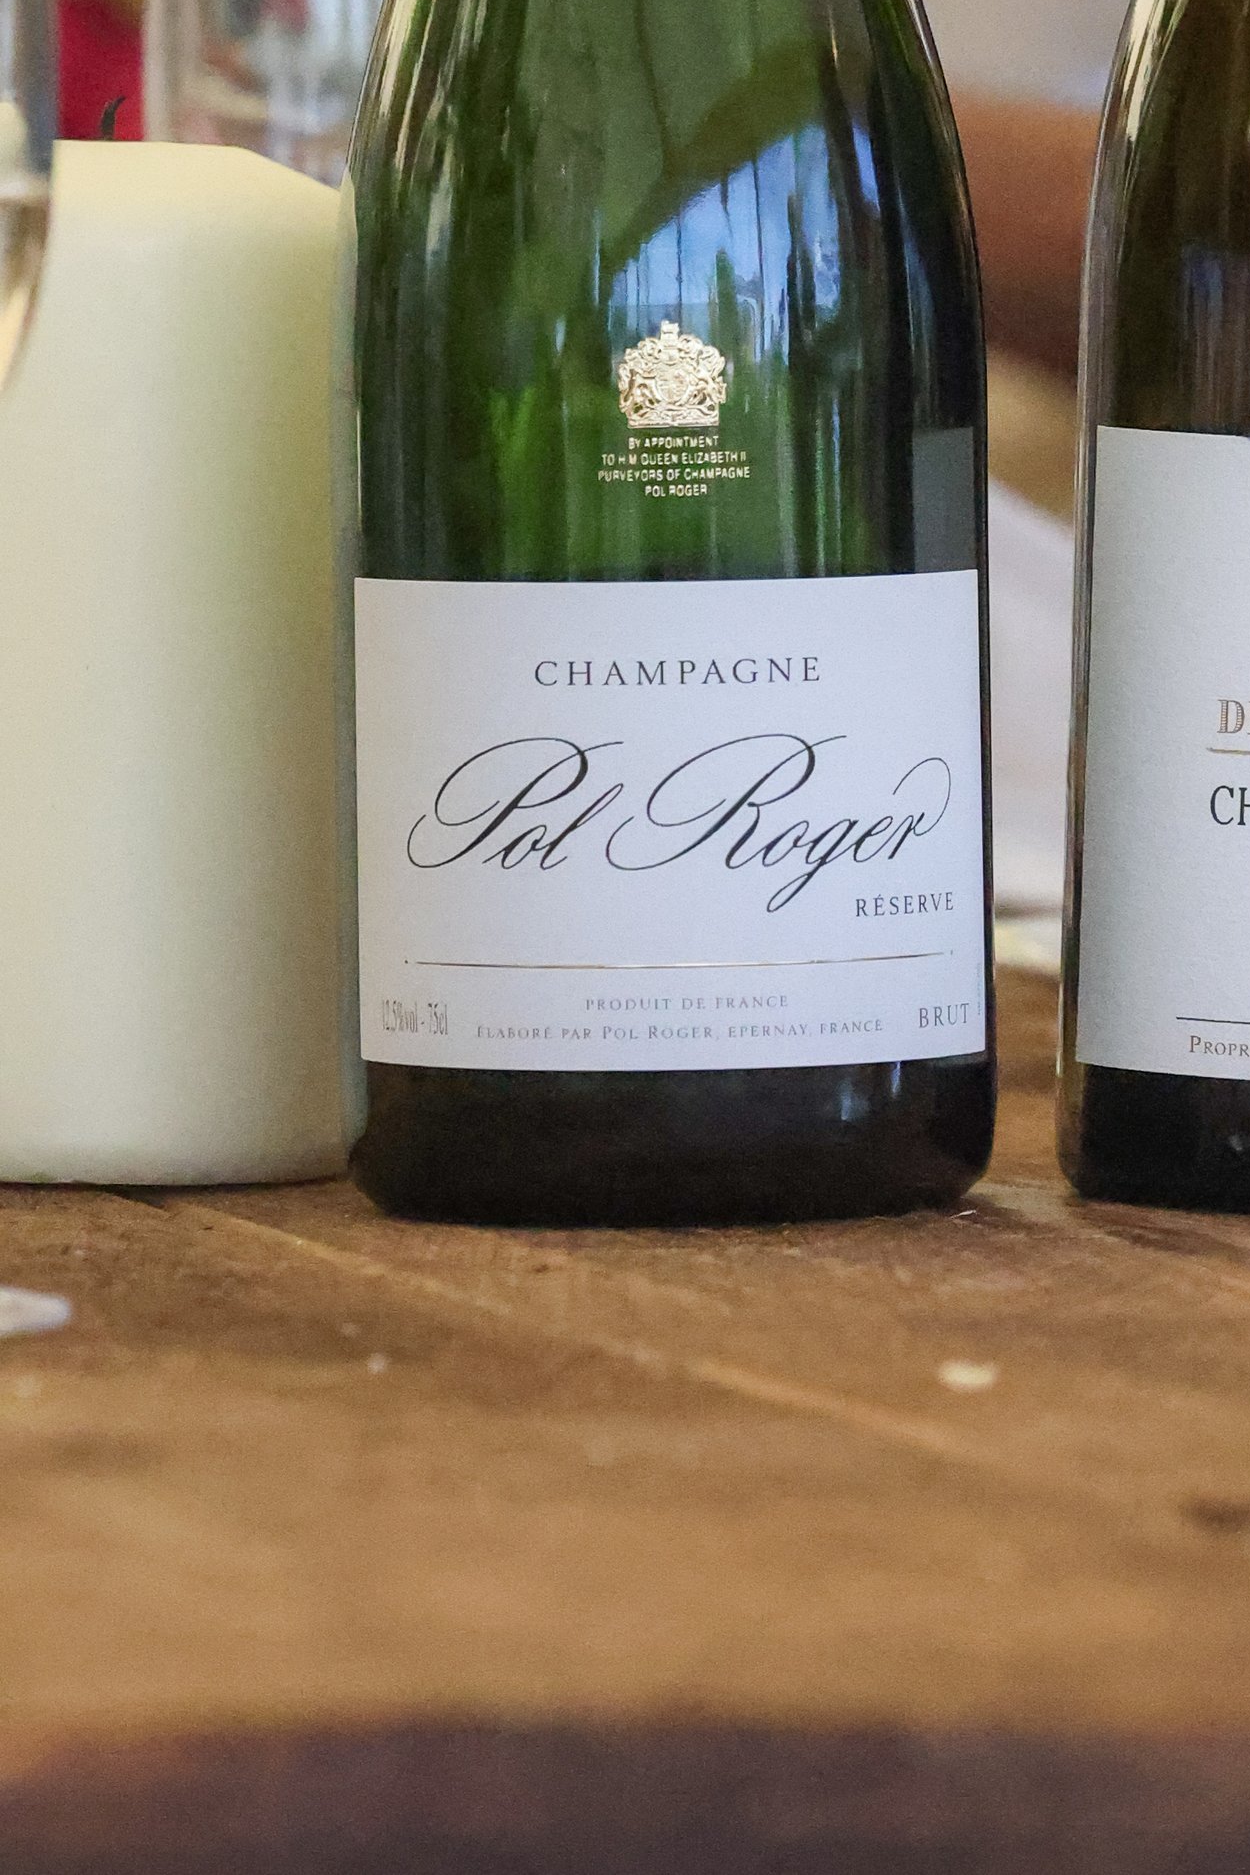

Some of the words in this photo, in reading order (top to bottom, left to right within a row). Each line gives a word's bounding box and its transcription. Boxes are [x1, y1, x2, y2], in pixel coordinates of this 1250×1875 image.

[628, 437, 641, 450] BY
[643, 435, 719, 449] APPOINTMENT
[602, 454, 614, 466] TO
[641, 453, 678, 465] QUEEN
[681, 451, 738, 464] ELIZABETH
[598, 469, 663, 482] PURVEYORS
[666, 469, 680, 481] OF
[684, 466, 750, 480] CHAMPAGNE
[645, 485, 666, 497] POL
[669, 484, 707, 497] ROGER
[534, 656, 822, 687] CHAMPAGNE
[407, 737, 624, 871] Pol
[605, 733, 952, 914] Roger
[855, 891, 955, 918] RÉSERVE
[586, 997, 672, 1011] PRODUIT
[681, 998, 706, 1010] DE
[715, 994, 788, 1009] FRANCE
[918, 1002, 970, 1029] BRUT
[561, 1027, 592, 1040] PAR
[819, 1018, 883, 1035] FRANCE
